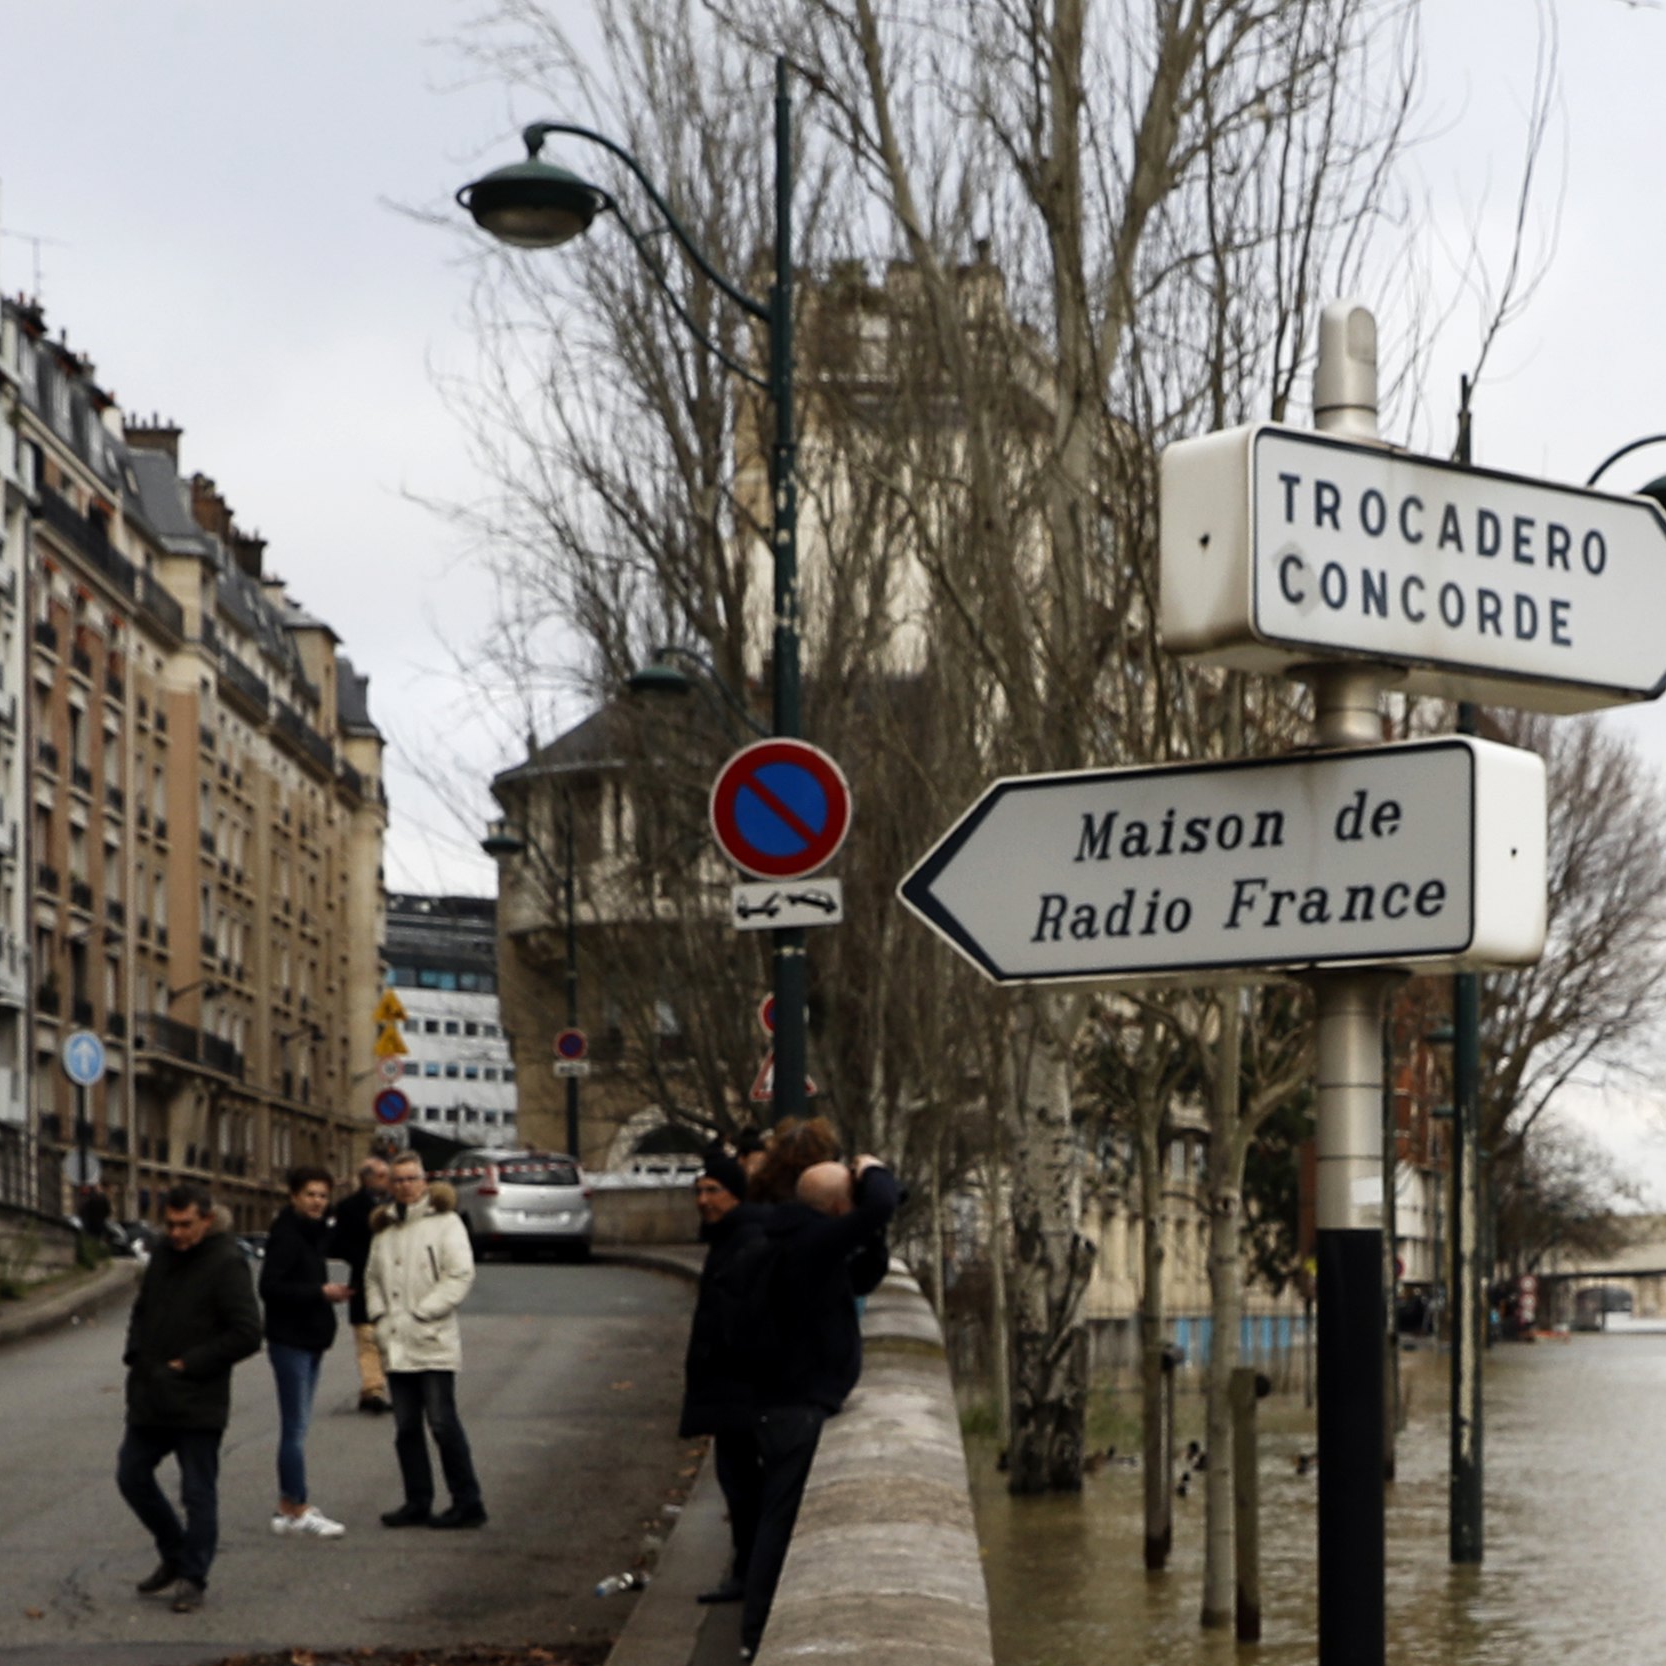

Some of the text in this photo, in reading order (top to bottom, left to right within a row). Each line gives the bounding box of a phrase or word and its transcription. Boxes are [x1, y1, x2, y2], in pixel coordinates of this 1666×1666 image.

[1278, 472, 1608, 577] TROCADERO
[1278, 553, 1573, 648] CONCORDE
[1071, 787, 1405, 865] Maison de
[1028, 876, 1449, 945] Radio France
